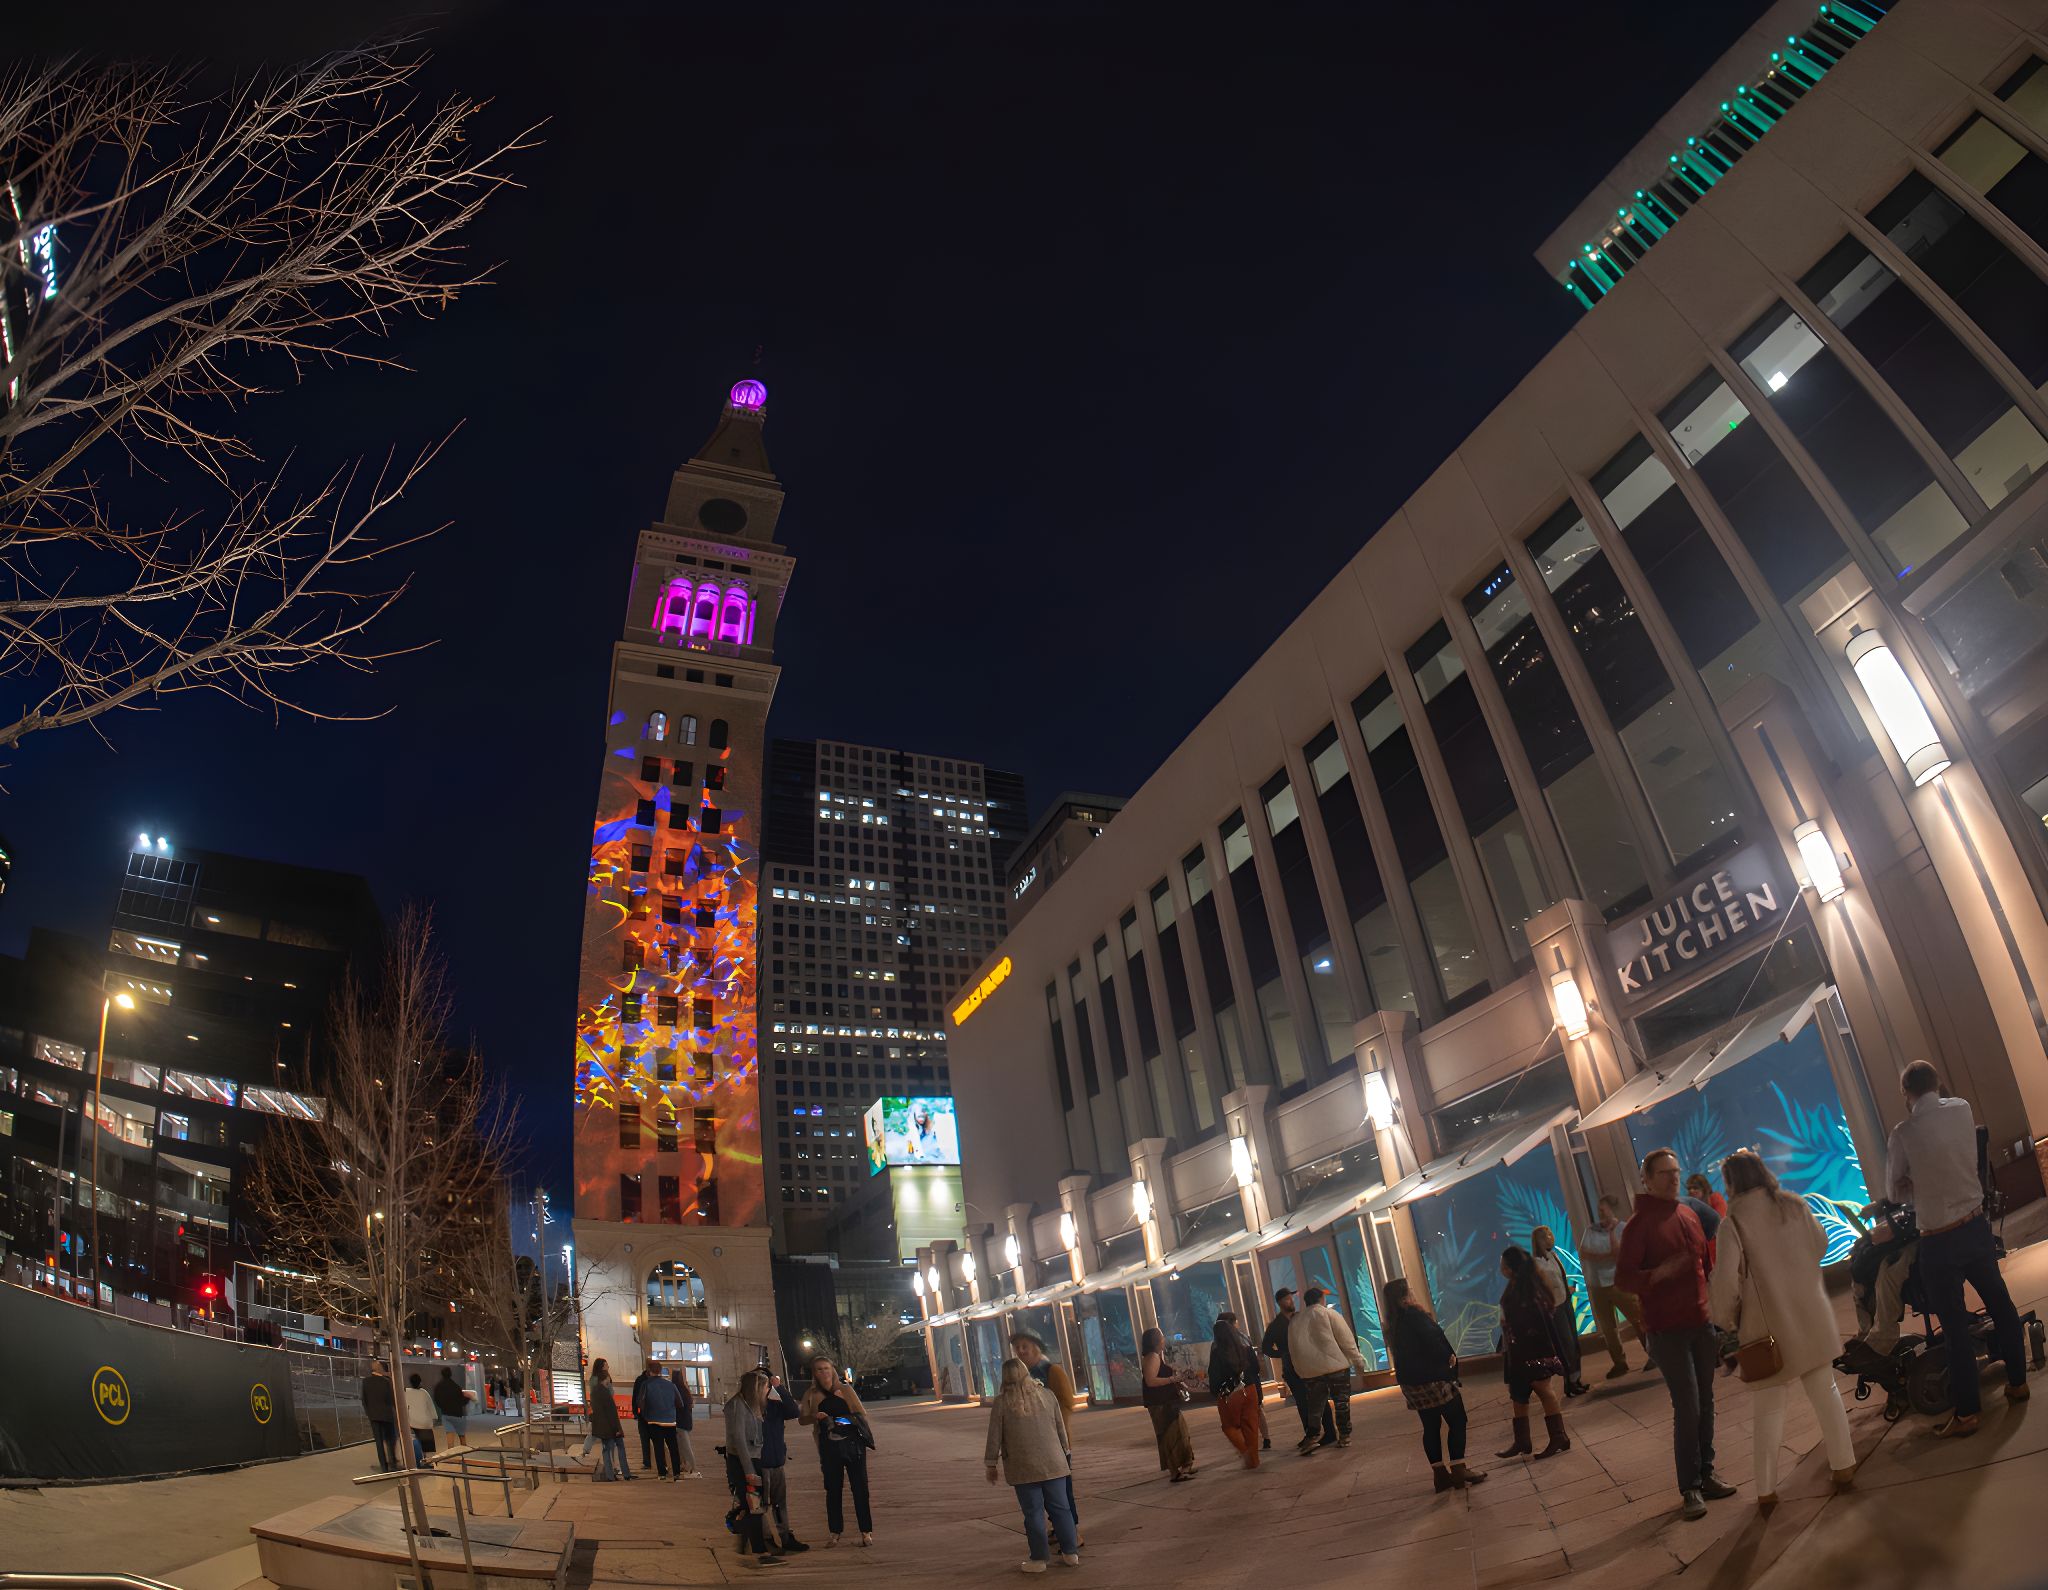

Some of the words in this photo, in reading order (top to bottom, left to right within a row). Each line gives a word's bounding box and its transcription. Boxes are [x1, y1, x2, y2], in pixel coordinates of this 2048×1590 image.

[1640, 870, 1734, 946] JUICE
[1617, 882, 1777, 994] KITCHEN
[99, 1382, 125, 1407] PCL
[253, 1395, 270, 1411] PCL
